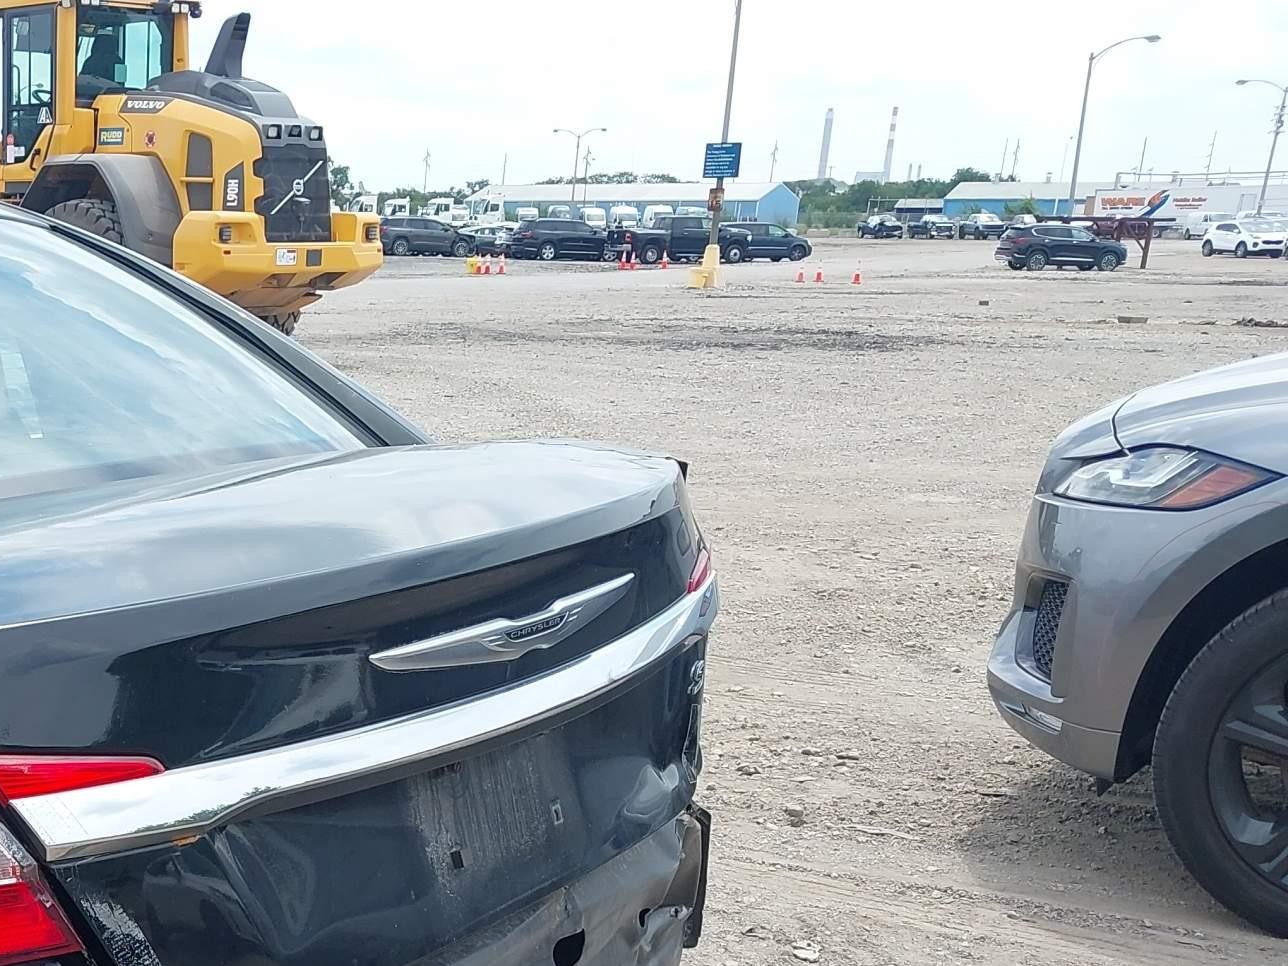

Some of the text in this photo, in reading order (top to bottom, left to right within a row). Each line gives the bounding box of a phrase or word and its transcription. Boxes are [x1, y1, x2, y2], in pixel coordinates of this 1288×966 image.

[126, 100, 165, 109] VOLVO
[226, 179, 240, 206] L90H
[509, 616, 562, 639] CHRYSLER
